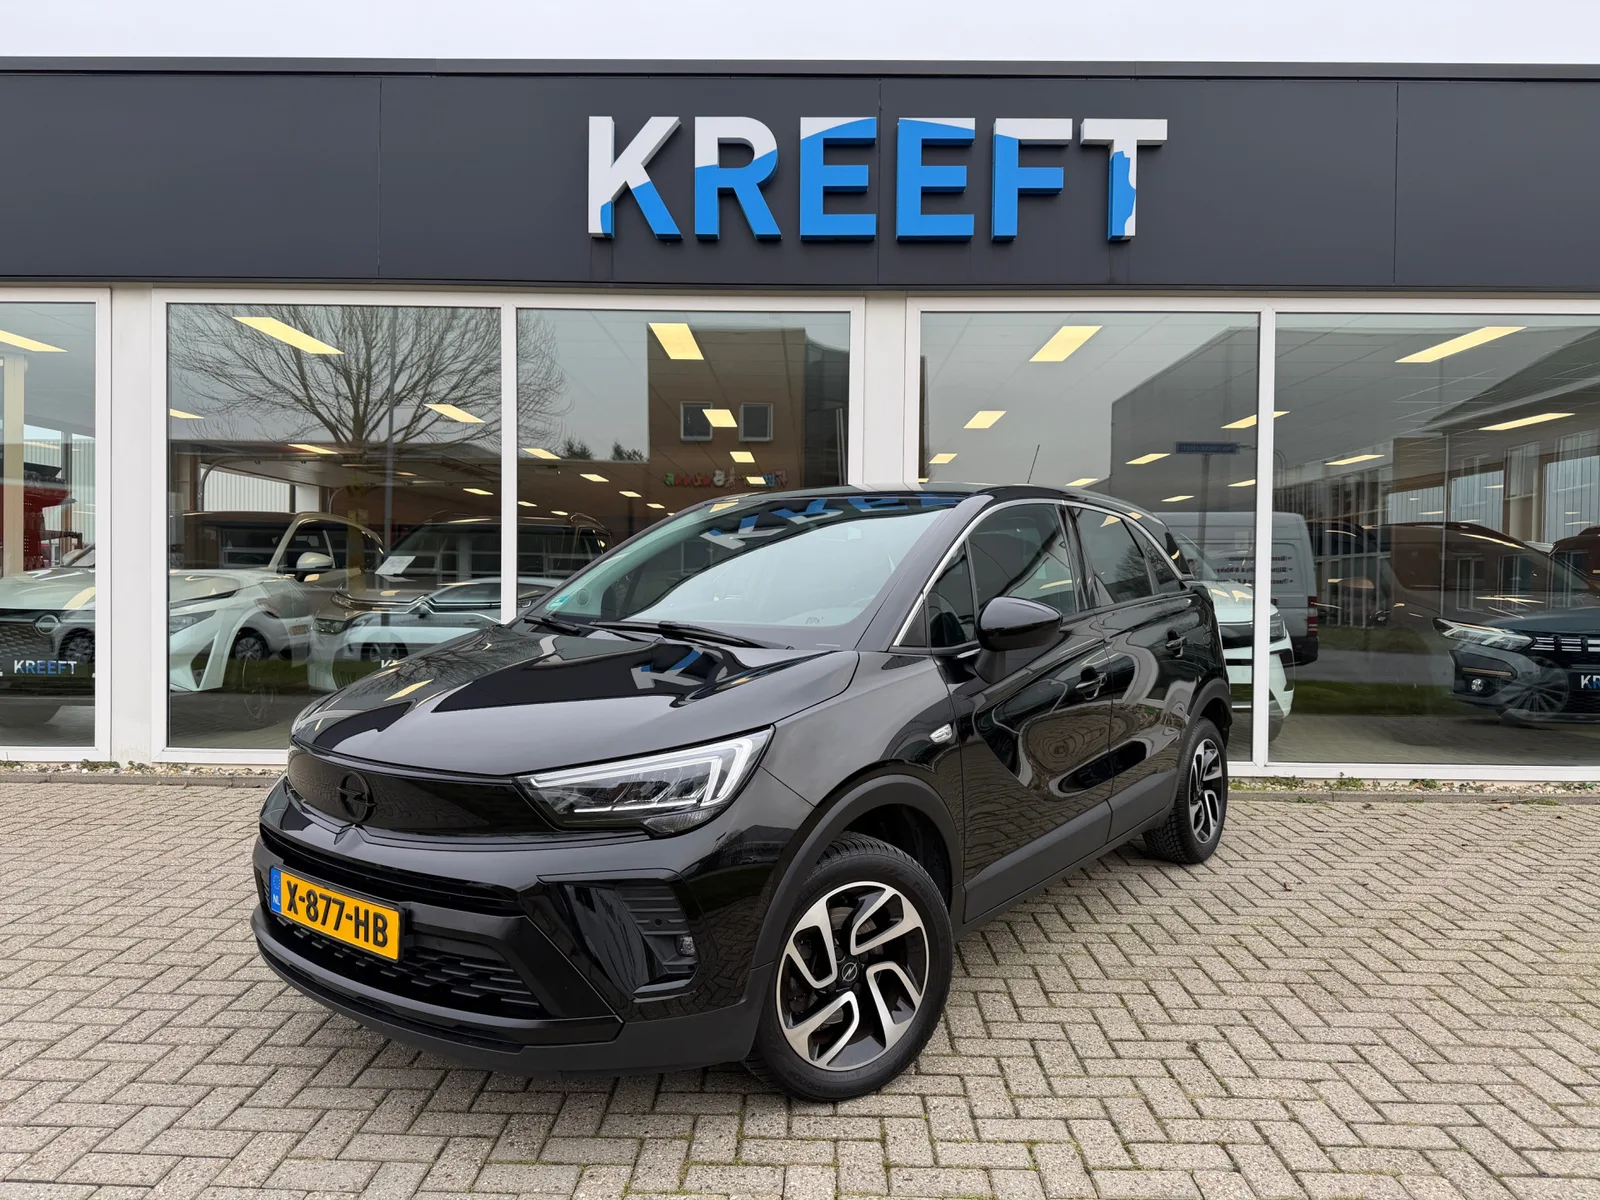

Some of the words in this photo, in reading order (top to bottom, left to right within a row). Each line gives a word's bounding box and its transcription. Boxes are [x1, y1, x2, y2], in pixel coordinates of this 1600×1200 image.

[588, 115, 1168, 240] KREEFT
[14, 660, 77, 675] KREEFT
[272, 894, 281, 906] NL
[286, 880, 389, 948] X-877-HB
